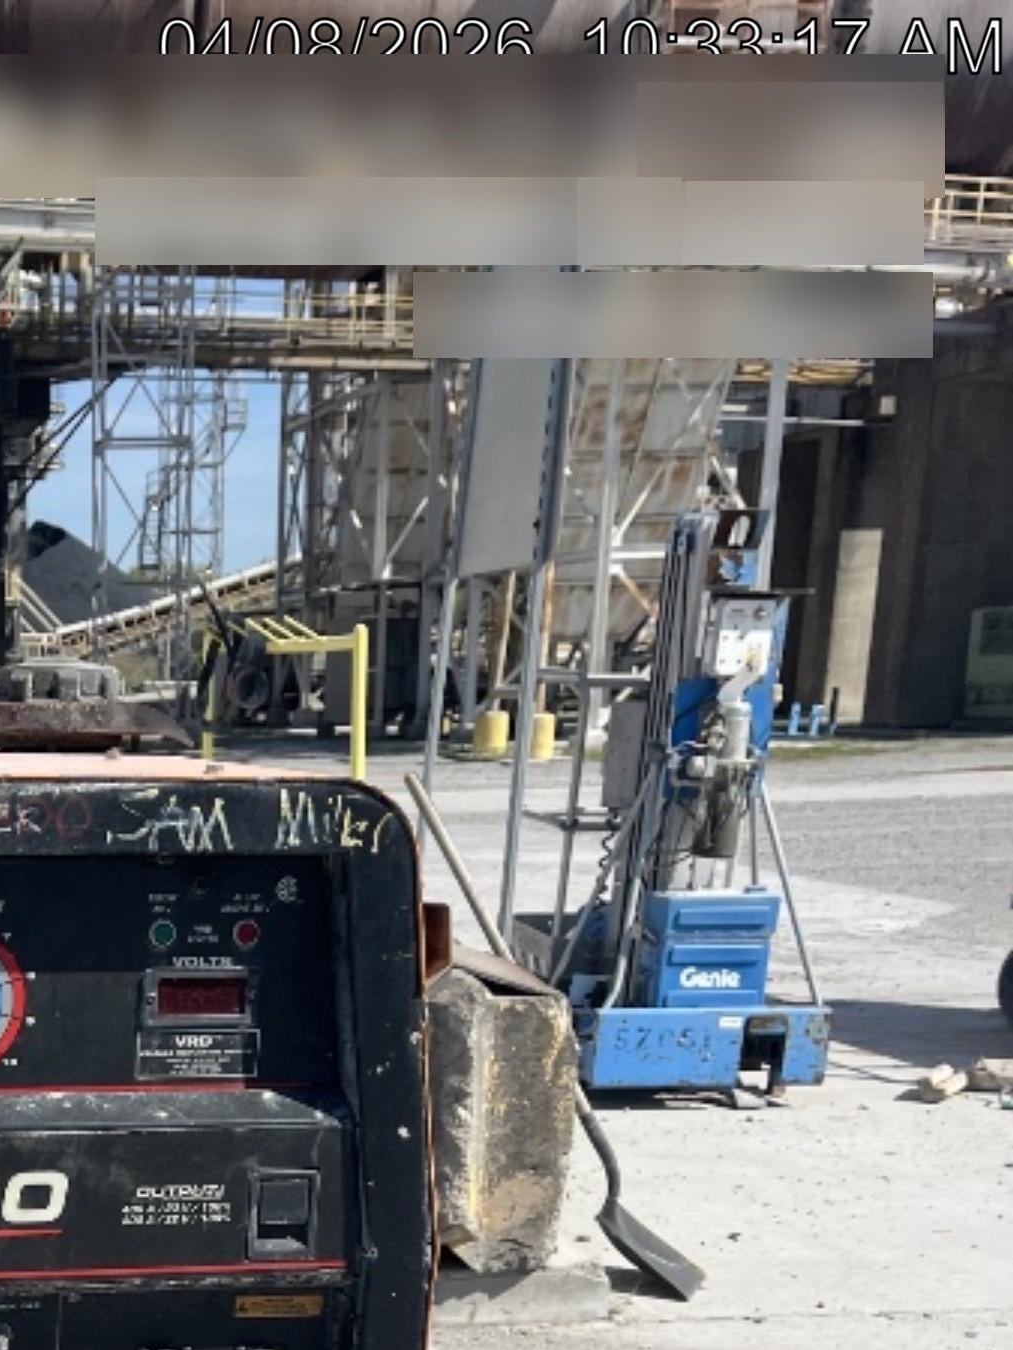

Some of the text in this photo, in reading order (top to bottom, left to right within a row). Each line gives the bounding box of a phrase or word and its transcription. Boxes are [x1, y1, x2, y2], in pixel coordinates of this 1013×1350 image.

[171, 955, 234, 969] VOLTS
[679, 966, 741, 988] Genie
[174, 1034, 214, 1049] VRD
